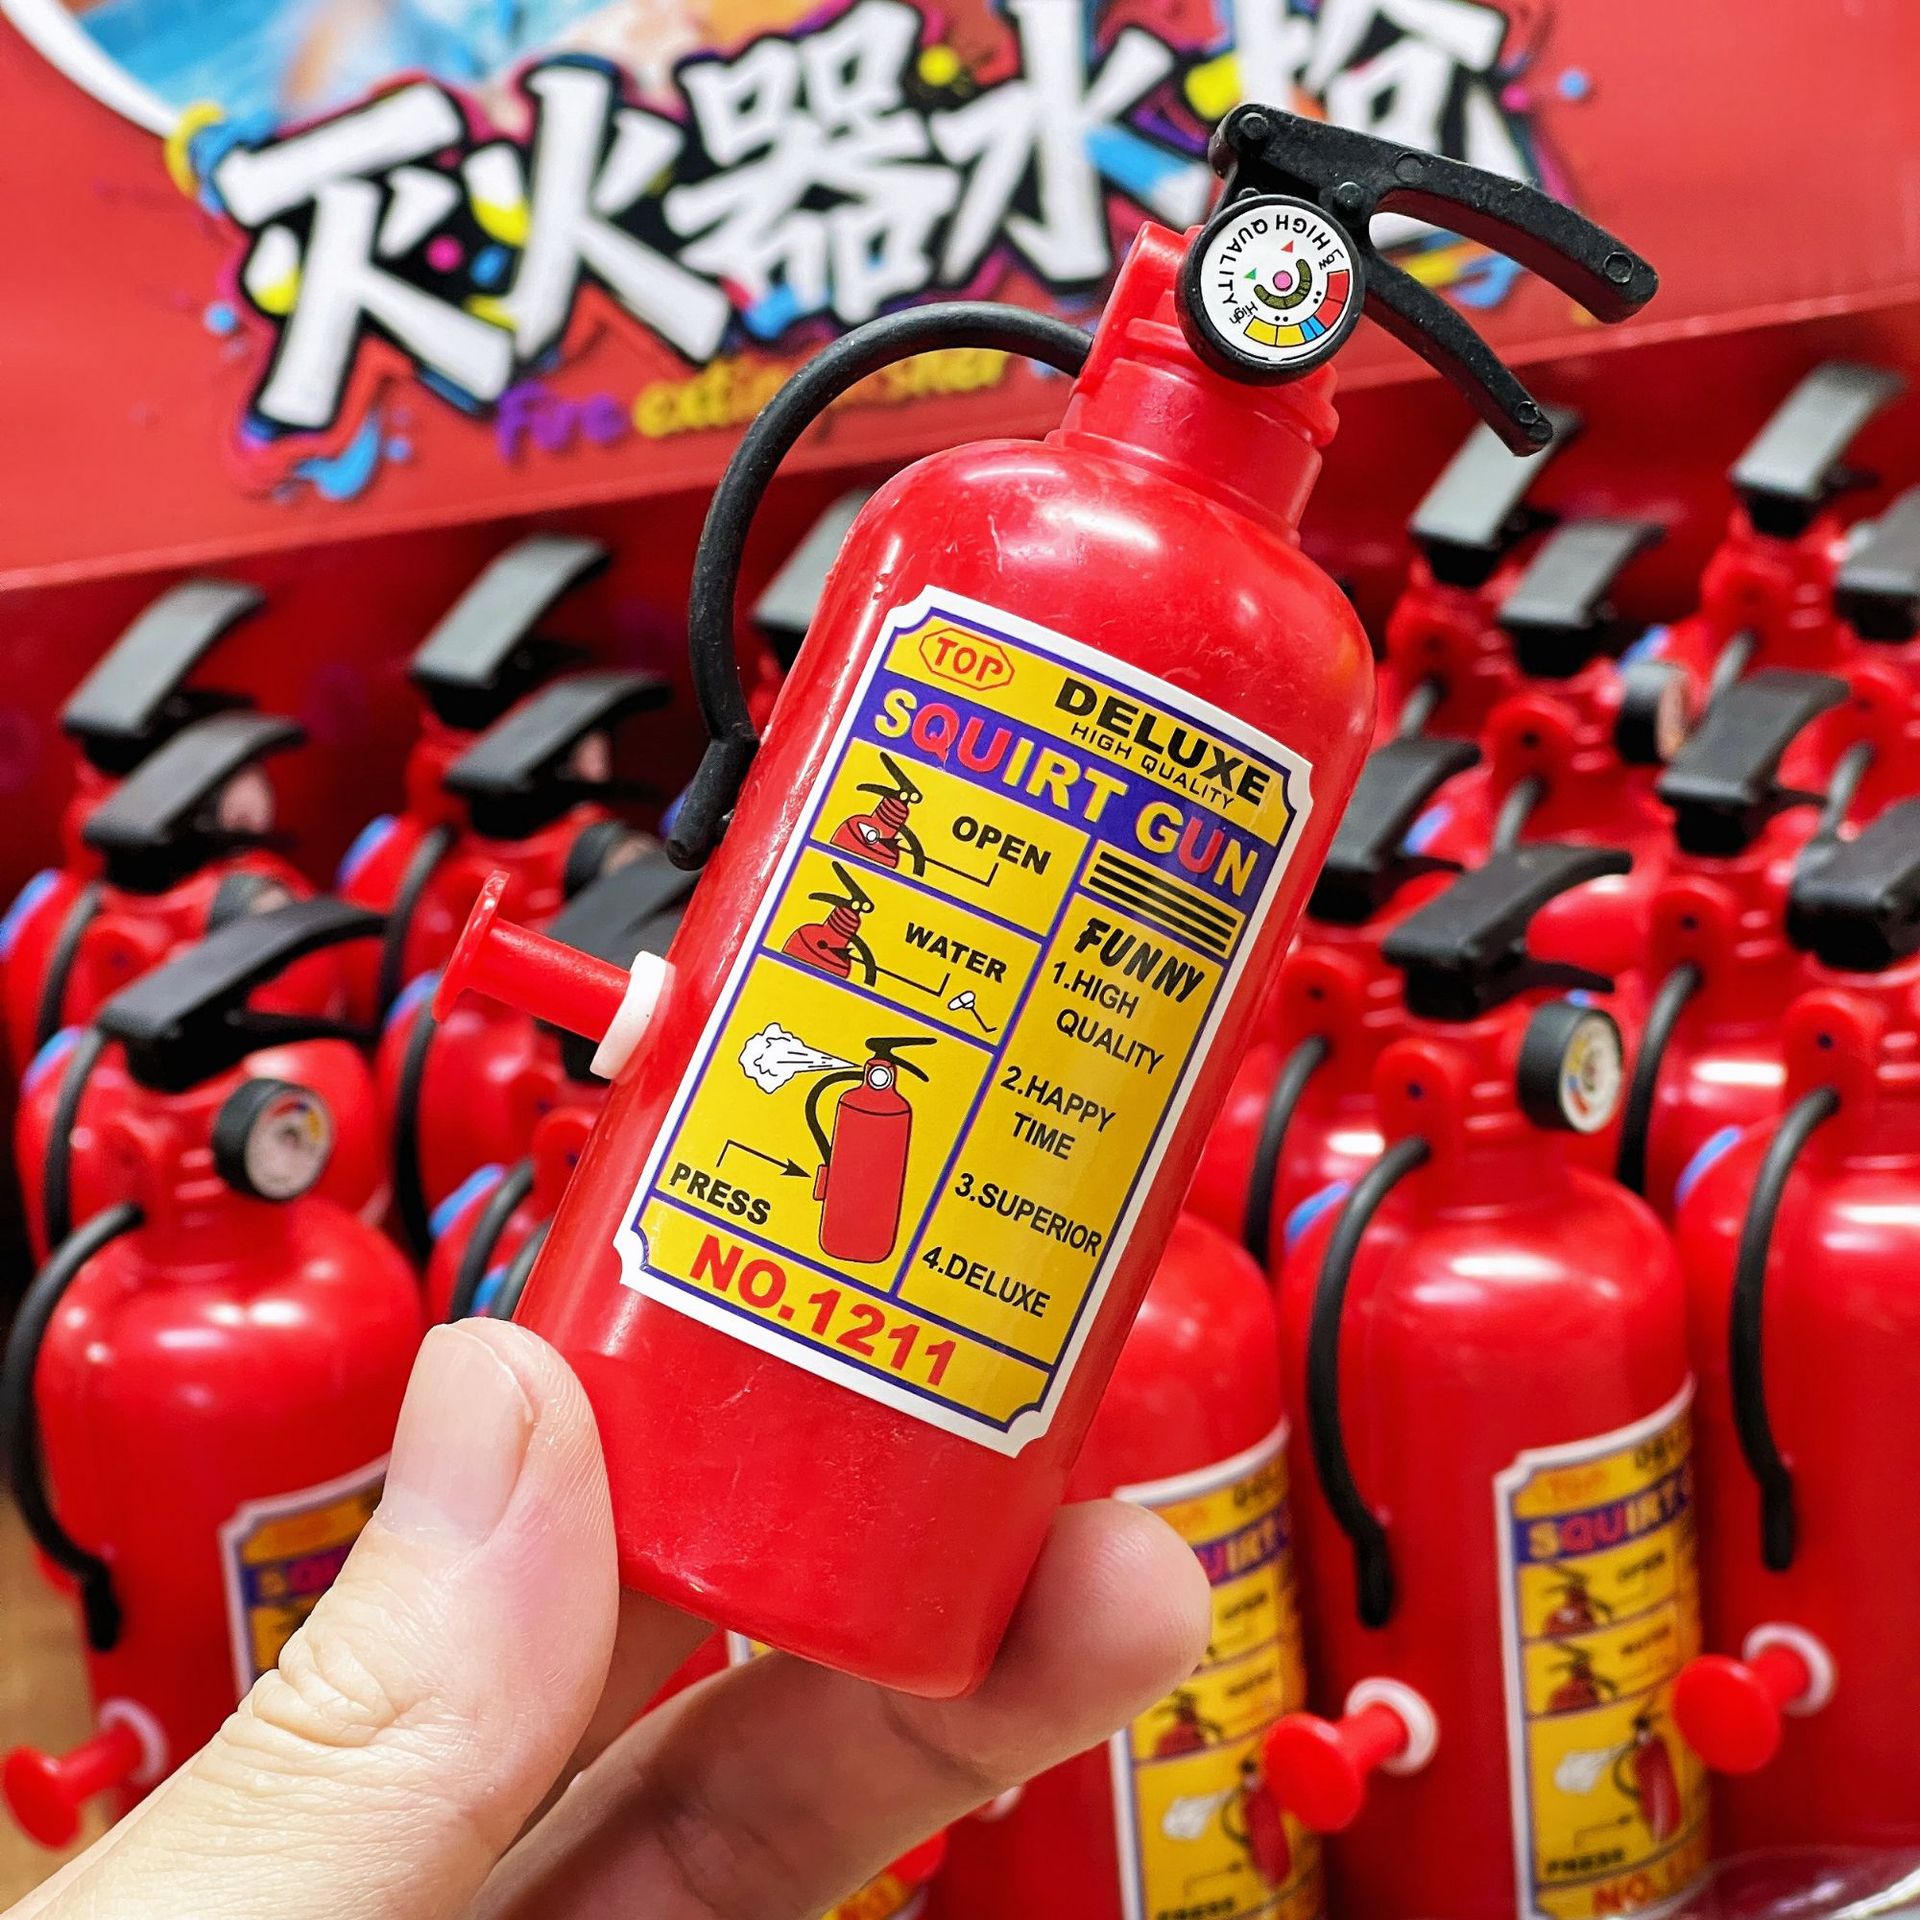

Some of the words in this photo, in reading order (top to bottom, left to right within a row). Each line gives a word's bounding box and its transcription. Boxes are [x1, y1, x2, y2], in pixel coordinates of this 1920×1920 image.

[1217, 218, 1269, 305] QUALITY
[1276, 214, 1331, 251] HIGH
[1318, 249, 1345, 271] Low
[1228, 301, 1259, 325] High
[933, 636, 1003, 682] TOP
[1054, 677, 1271, 807] DELUXE
[1071, 721, 1132, 760] HIGH
[1140, 755, 1236, 811] QUALITY
[873, 688, 1130, 825] SQUIRT
[1135, 799, 1258, 897] GUN
[951, 814, 1052, 876] OPEN
[904, 921, 1008, 984] WATER
[1074, 917, 1206, 1004] FUNNY
[1051, 961, 1141, 1020] 1.HIGH
[1055, 1008, 1165, 1075] QUALITY
[1000, 1065, 1117, 1133] 2.HAPPY
[1012, 1111, 1076, 1160] TIME
[669, 1161, 772, 1226] PRESS
[954, 1172, 1102, 1257] 3.SUPERIOR
[688, 1233, 958, 1387] NO.1211
[921, 1246, 1052, 1319] 4.DELUXE
